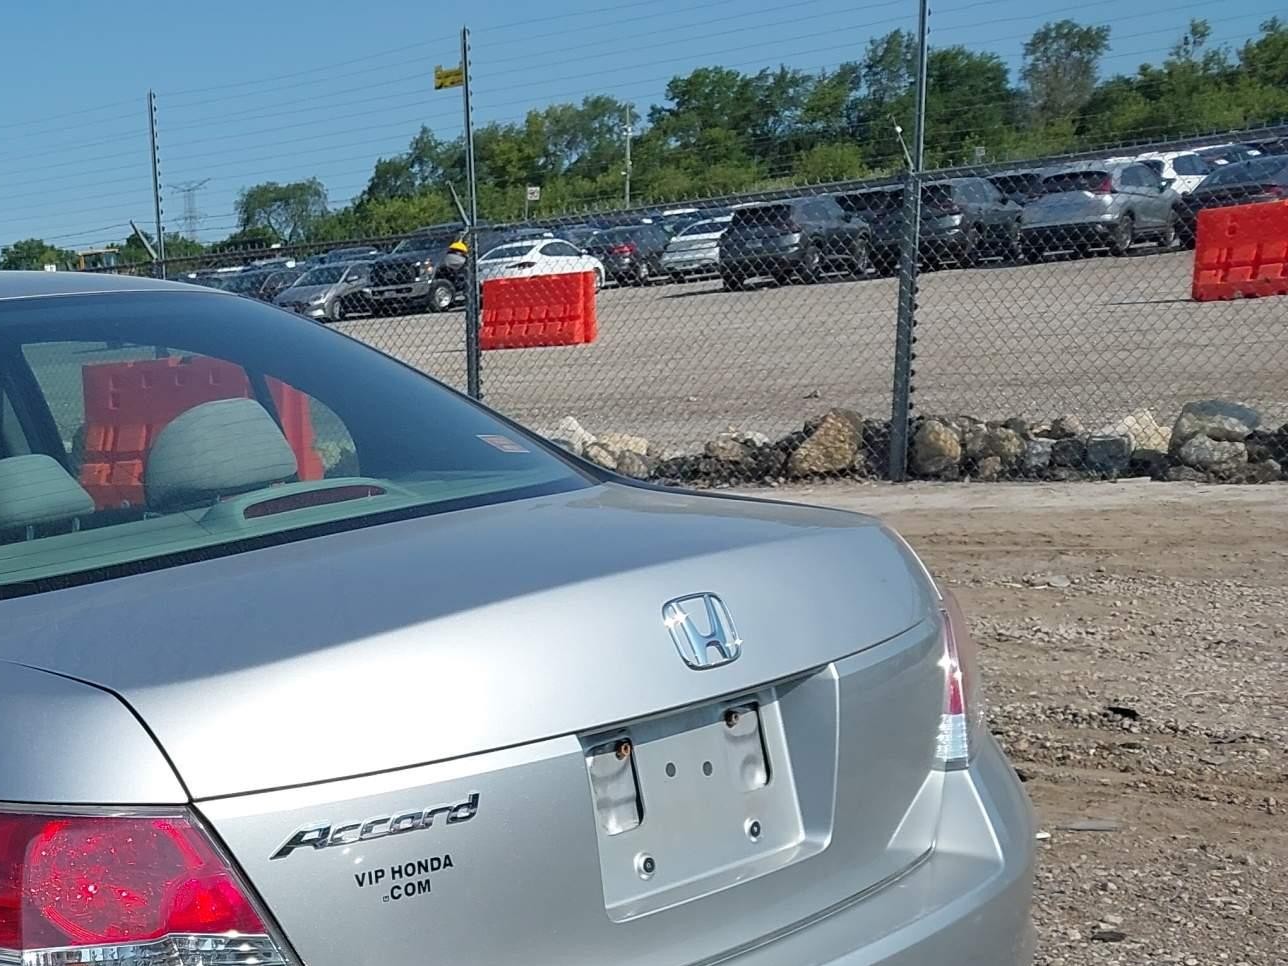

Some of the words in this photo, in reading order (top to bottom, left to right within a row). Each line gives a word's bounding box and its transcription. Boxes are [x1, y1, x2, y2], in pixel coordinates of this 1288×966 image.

[269, 790, 481, 861] Accord
[354, 868, 386, 888] VIP
[390, 854, 454, 881] HONDA
[382, 878, 432, 903] .COM
